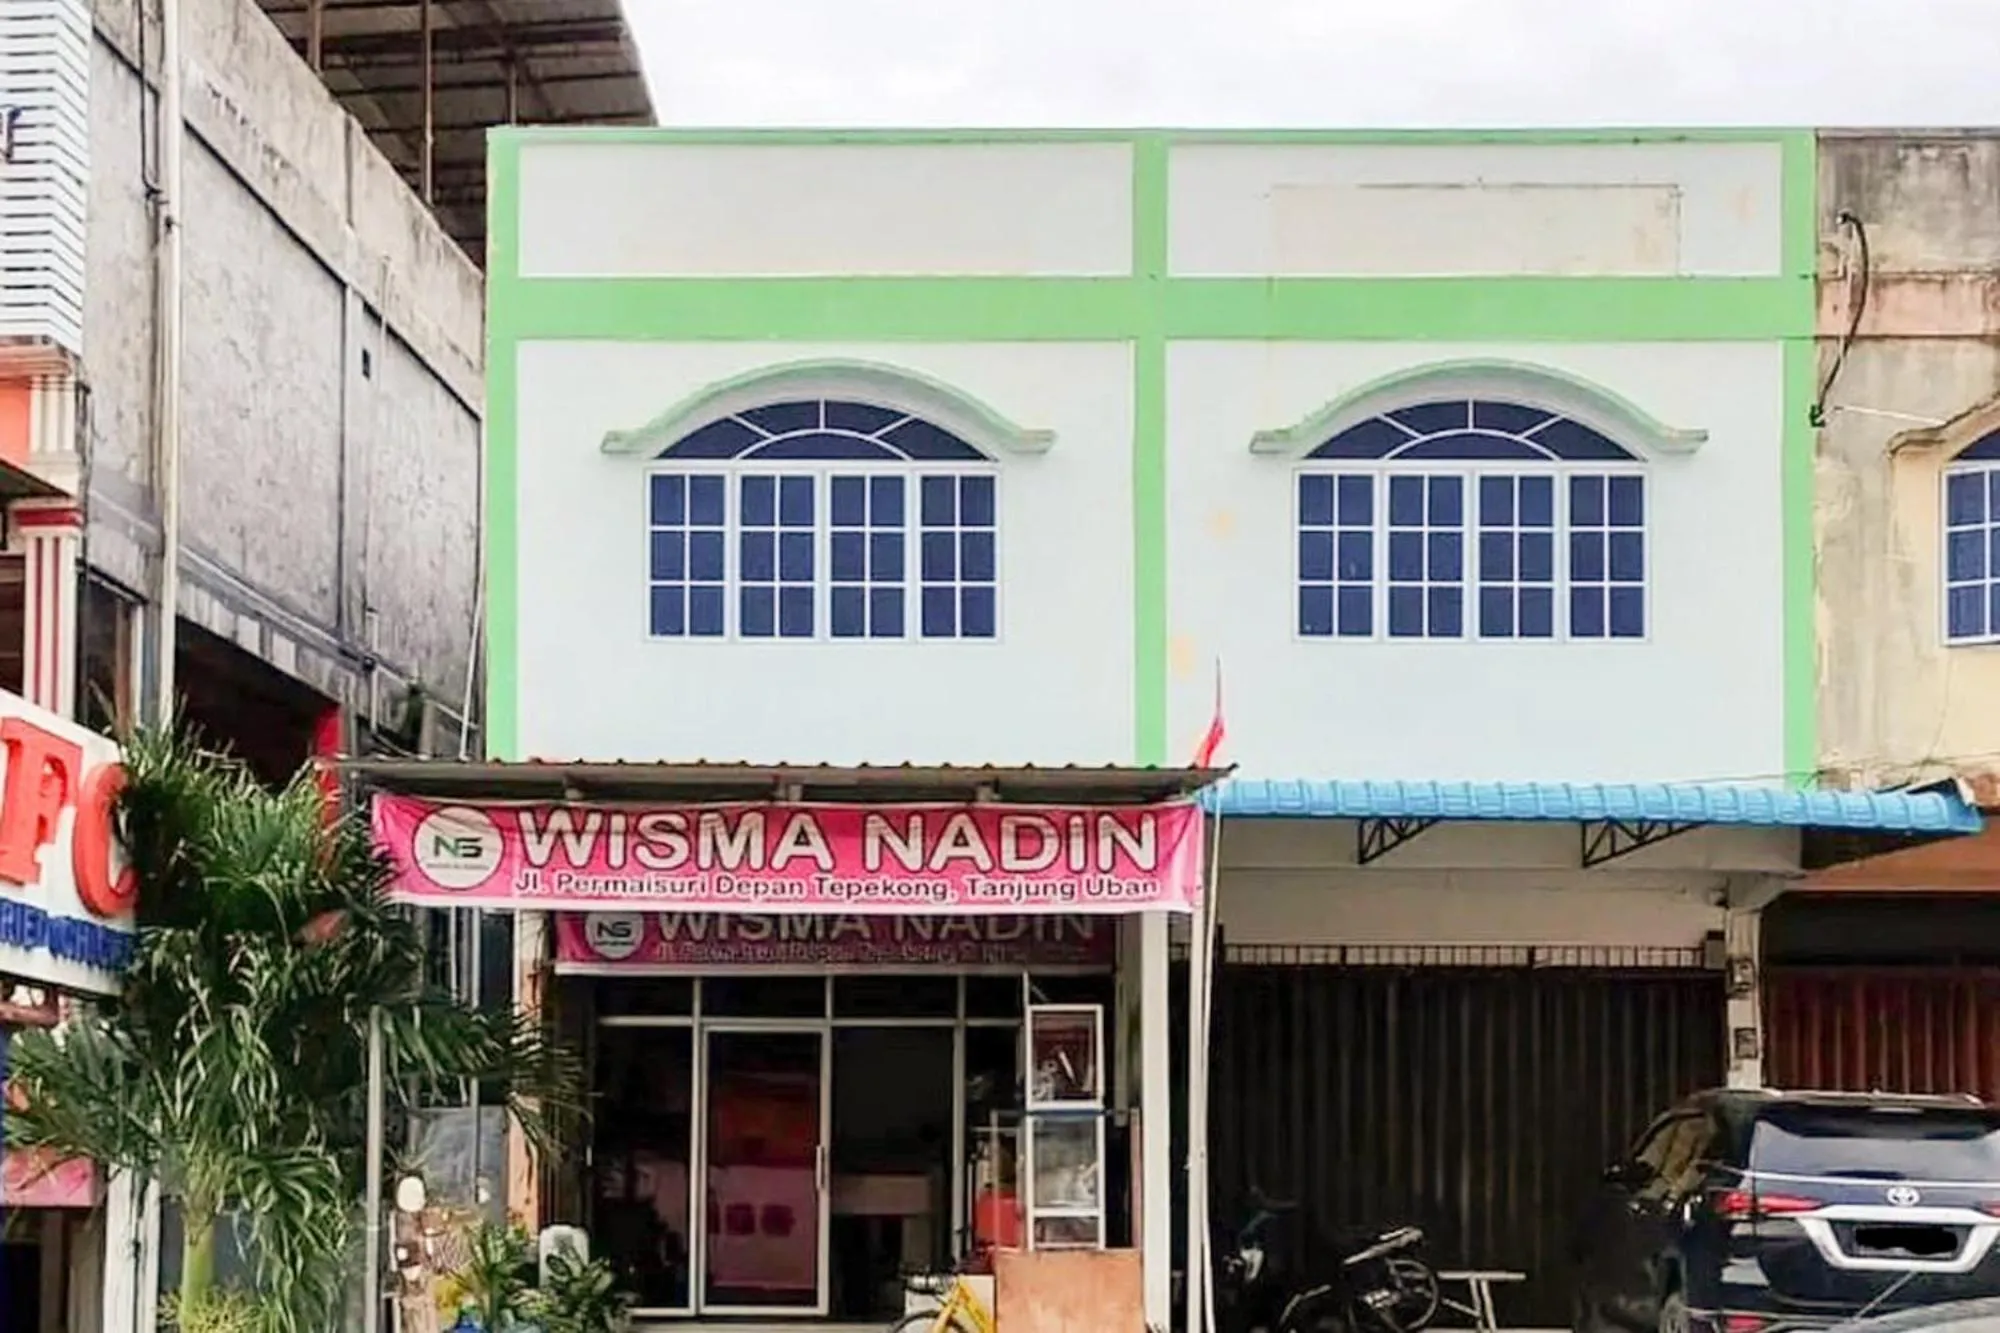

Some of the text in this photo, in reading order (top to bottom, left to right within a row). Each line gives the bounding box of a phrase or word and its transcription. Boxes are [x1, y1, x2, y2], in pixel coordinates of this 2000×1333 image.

[514, 807, 1158, 873] WISMA NADIN
[556, 873, 707, 894] Permaisuri
[715, 874, 808, 898] Depan
[966, 877, 1076, 899] Tanjung
[1084, 876, 1158, 897] Uban
